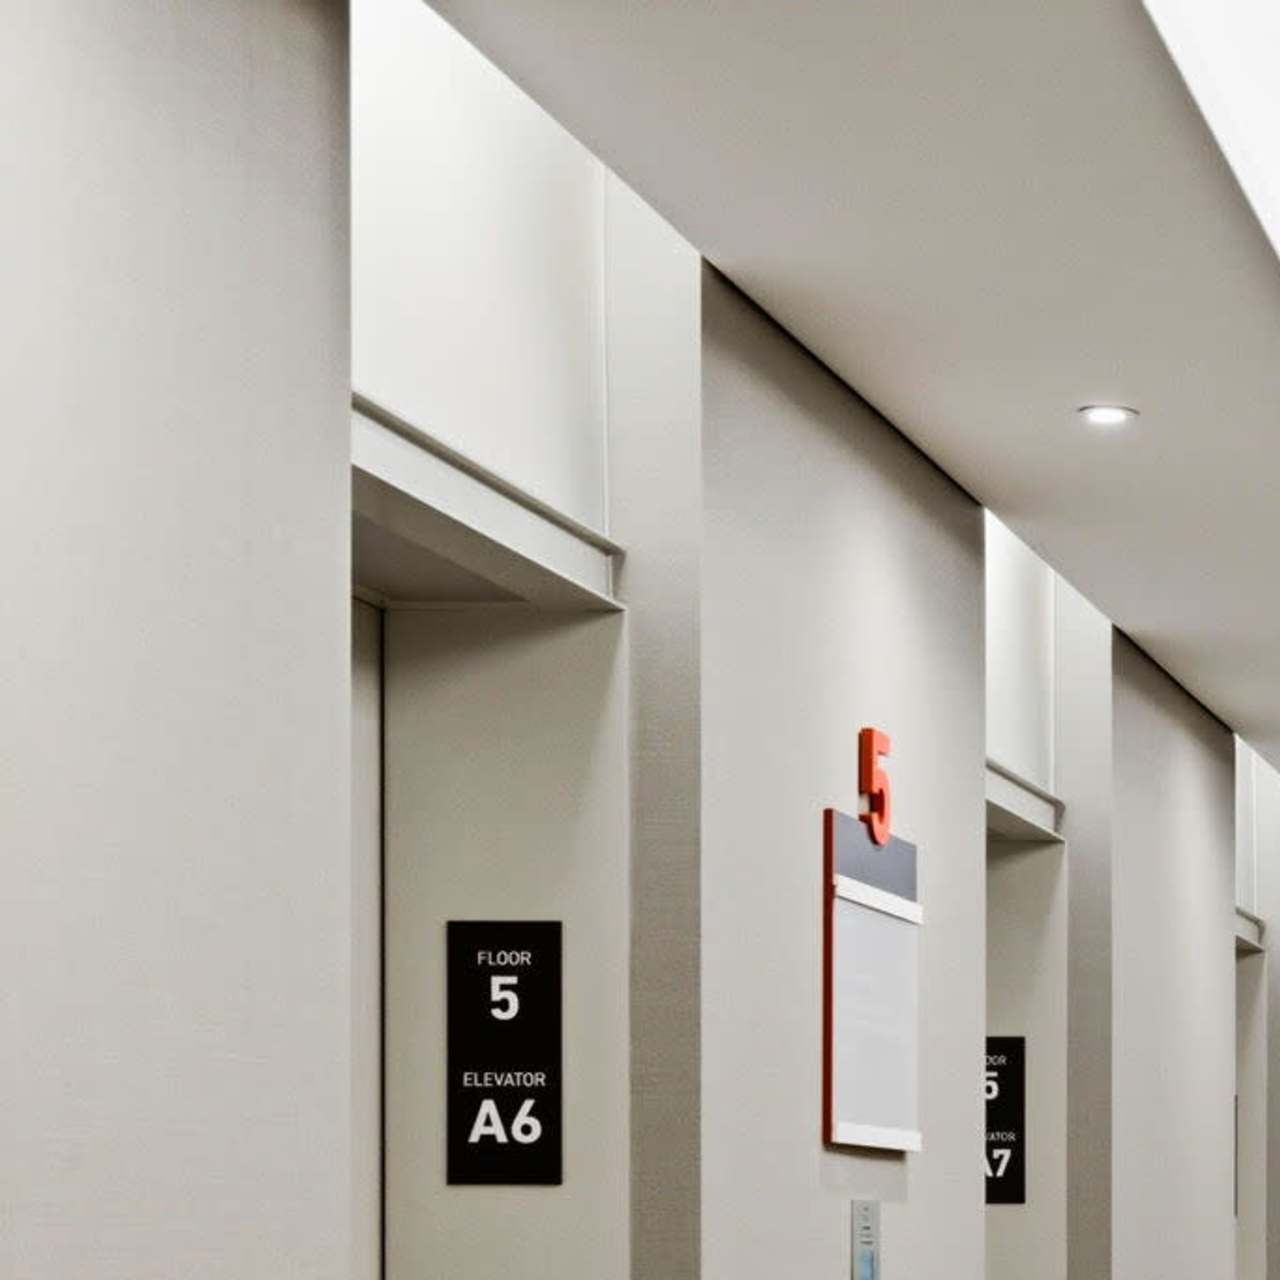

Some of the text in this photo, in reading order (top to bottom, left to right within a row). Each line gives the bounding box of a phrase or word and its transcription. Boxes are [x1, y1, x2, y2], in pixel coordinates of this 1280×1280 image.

[858, 727, 890, 846] 5
[477, 950, 532, 966] FLOOR
[490, 975, 520, 1020] 5
[985, 1055, 1007, 1066] OOR
[463, 1072, 546, 1087] ELEVATOR
[985, 1071, 999, 1100] 5
[468, 1099, 542, 1144] A6
